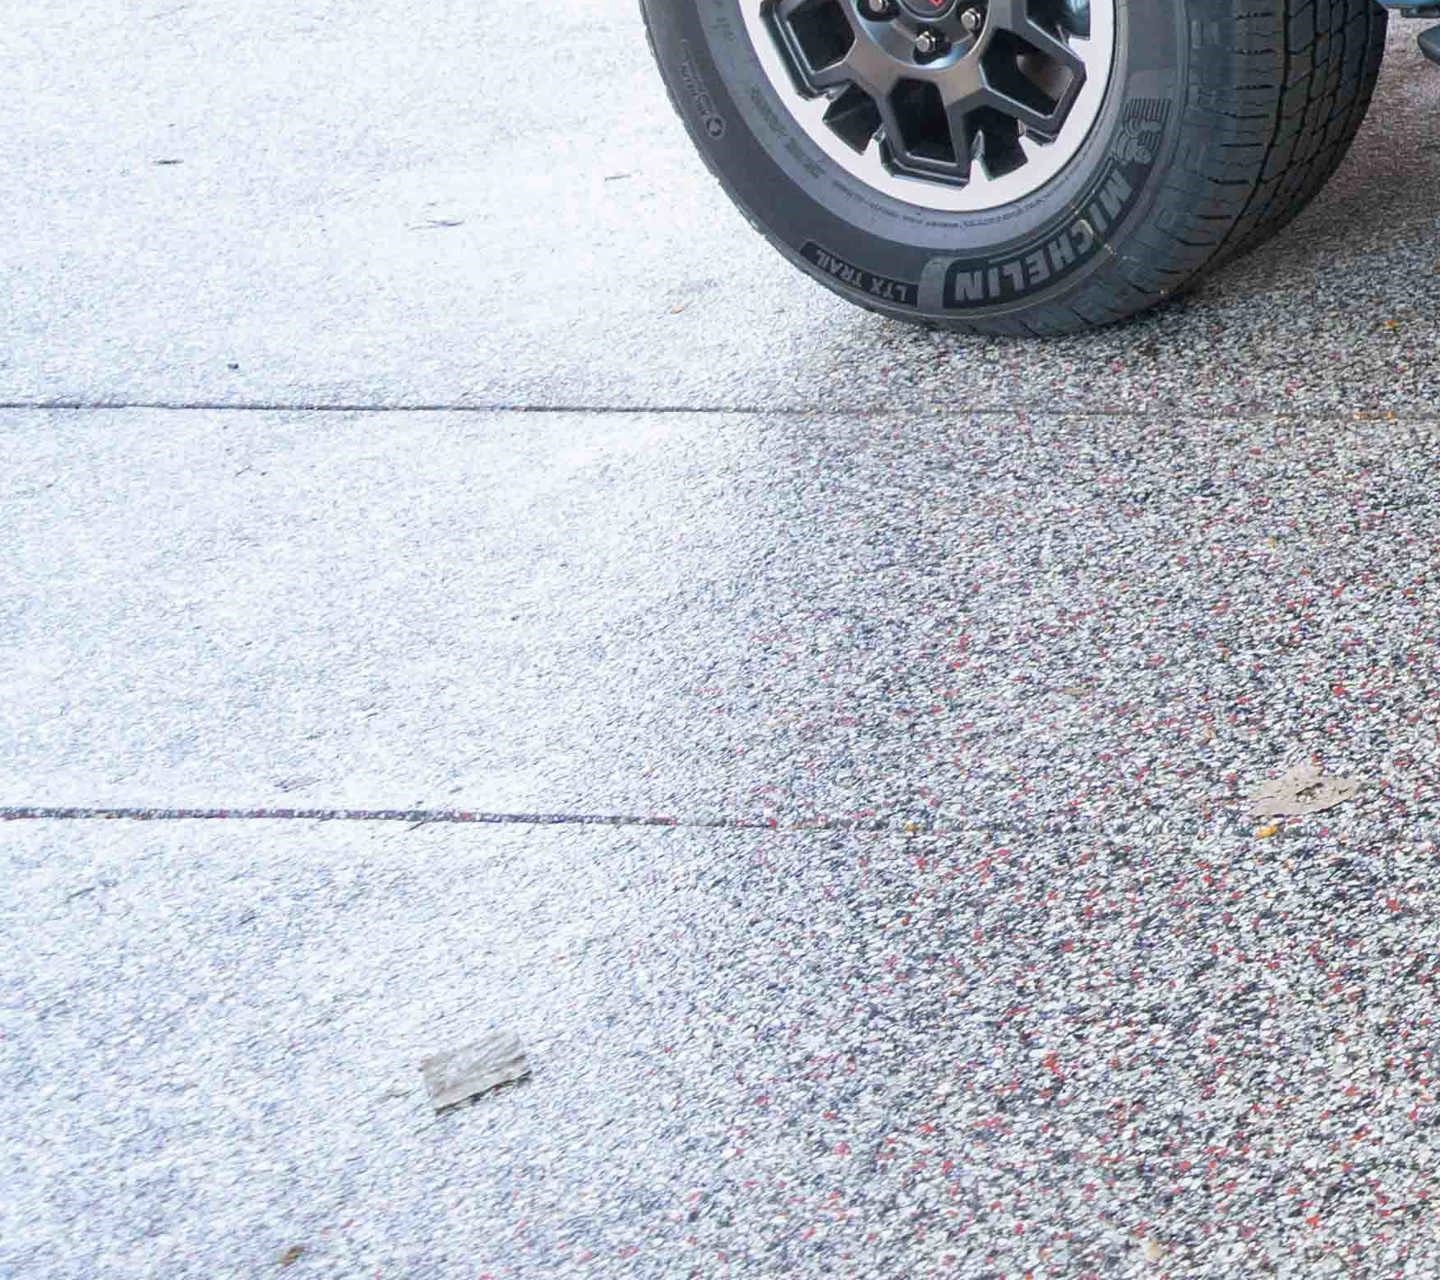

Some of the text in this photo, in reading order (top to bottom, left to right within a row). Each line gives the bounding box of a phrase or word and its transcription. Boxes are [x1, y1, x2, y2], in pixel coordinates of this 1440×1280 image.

[816, 247, 909, 305] LTX TRAIL
[955, 169, 1133, 302] MICHELIN
